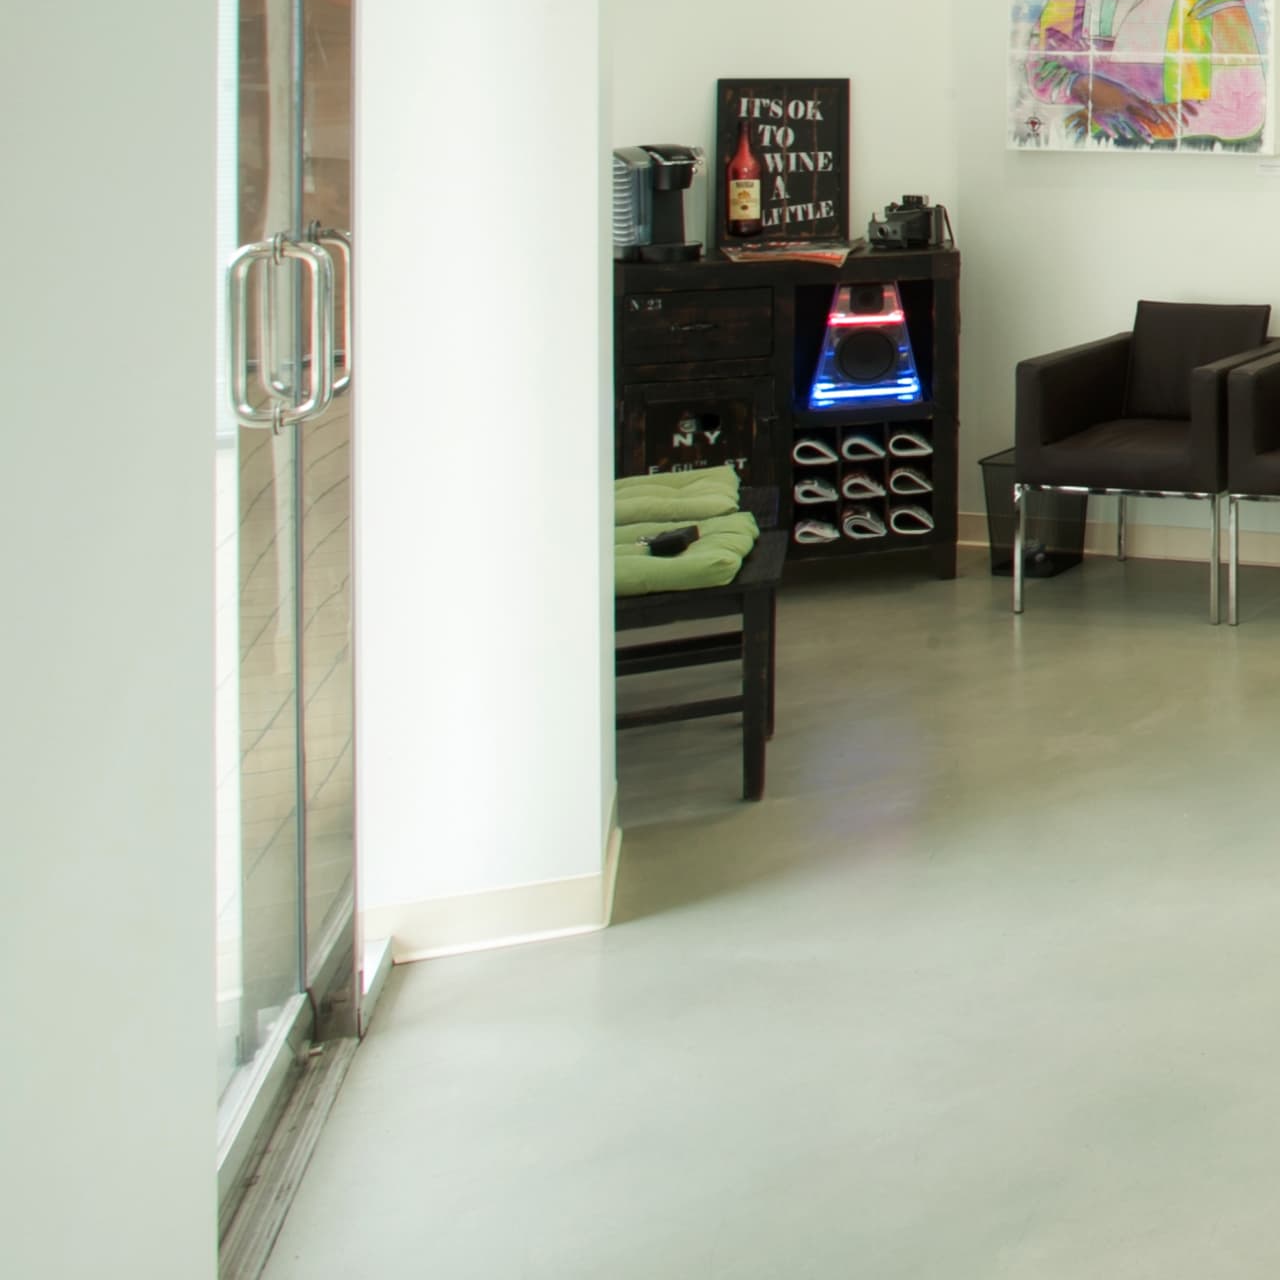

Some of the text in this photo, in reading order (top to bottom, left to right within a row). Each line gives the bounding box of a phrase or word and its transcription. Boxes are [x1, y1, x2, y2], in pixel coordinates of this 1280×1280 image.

[738, 96, 824, 121] IT'S OK
[758, 124, 795, 148] TO
[763, 151, 834, 173] WINE
[771, 175, 791, 200] A
[761, 200, 834, 227] LITTLE
